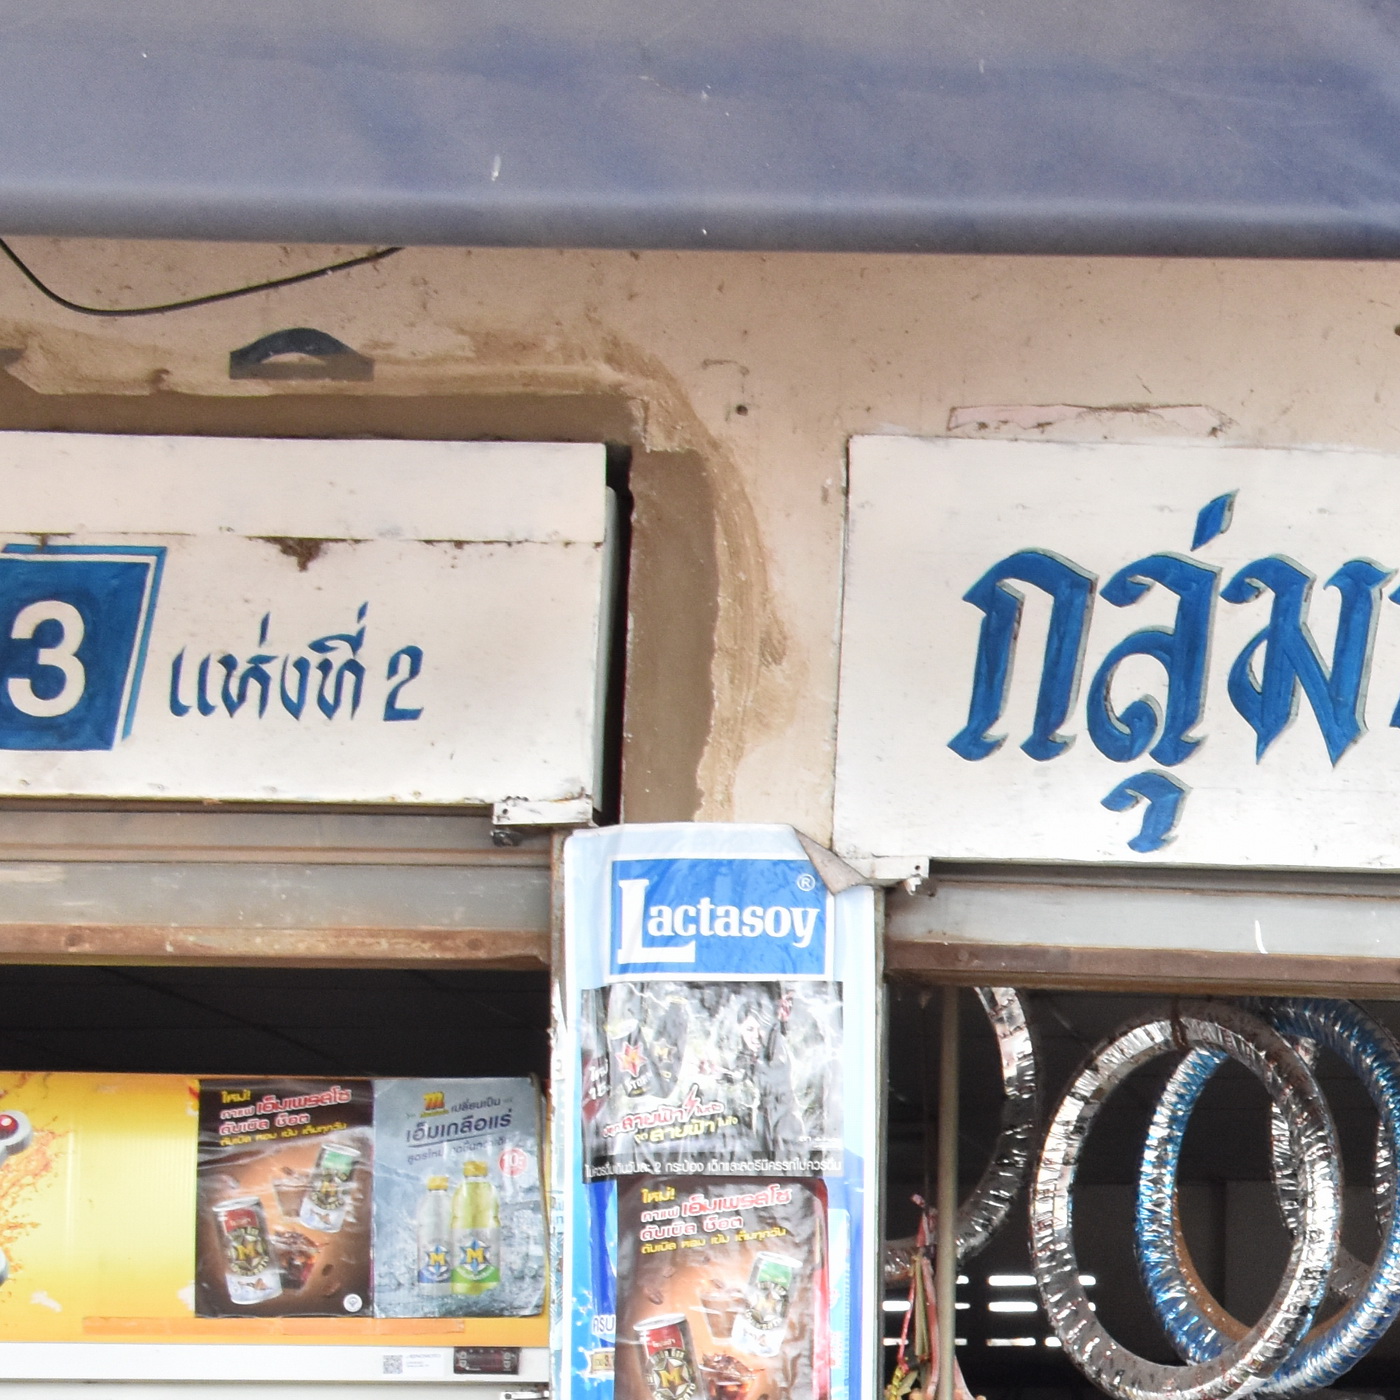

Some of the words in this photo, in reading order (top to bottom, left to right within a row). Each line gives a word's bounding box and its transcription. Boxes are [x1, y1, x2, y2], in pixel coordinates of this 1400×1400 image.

[4, 598, 86, 718] 3
[169, 602, 366, 720] แห่งที่
[383, 645, 424, 722] 2
[616, 877, 820, 966] Lactasoy
